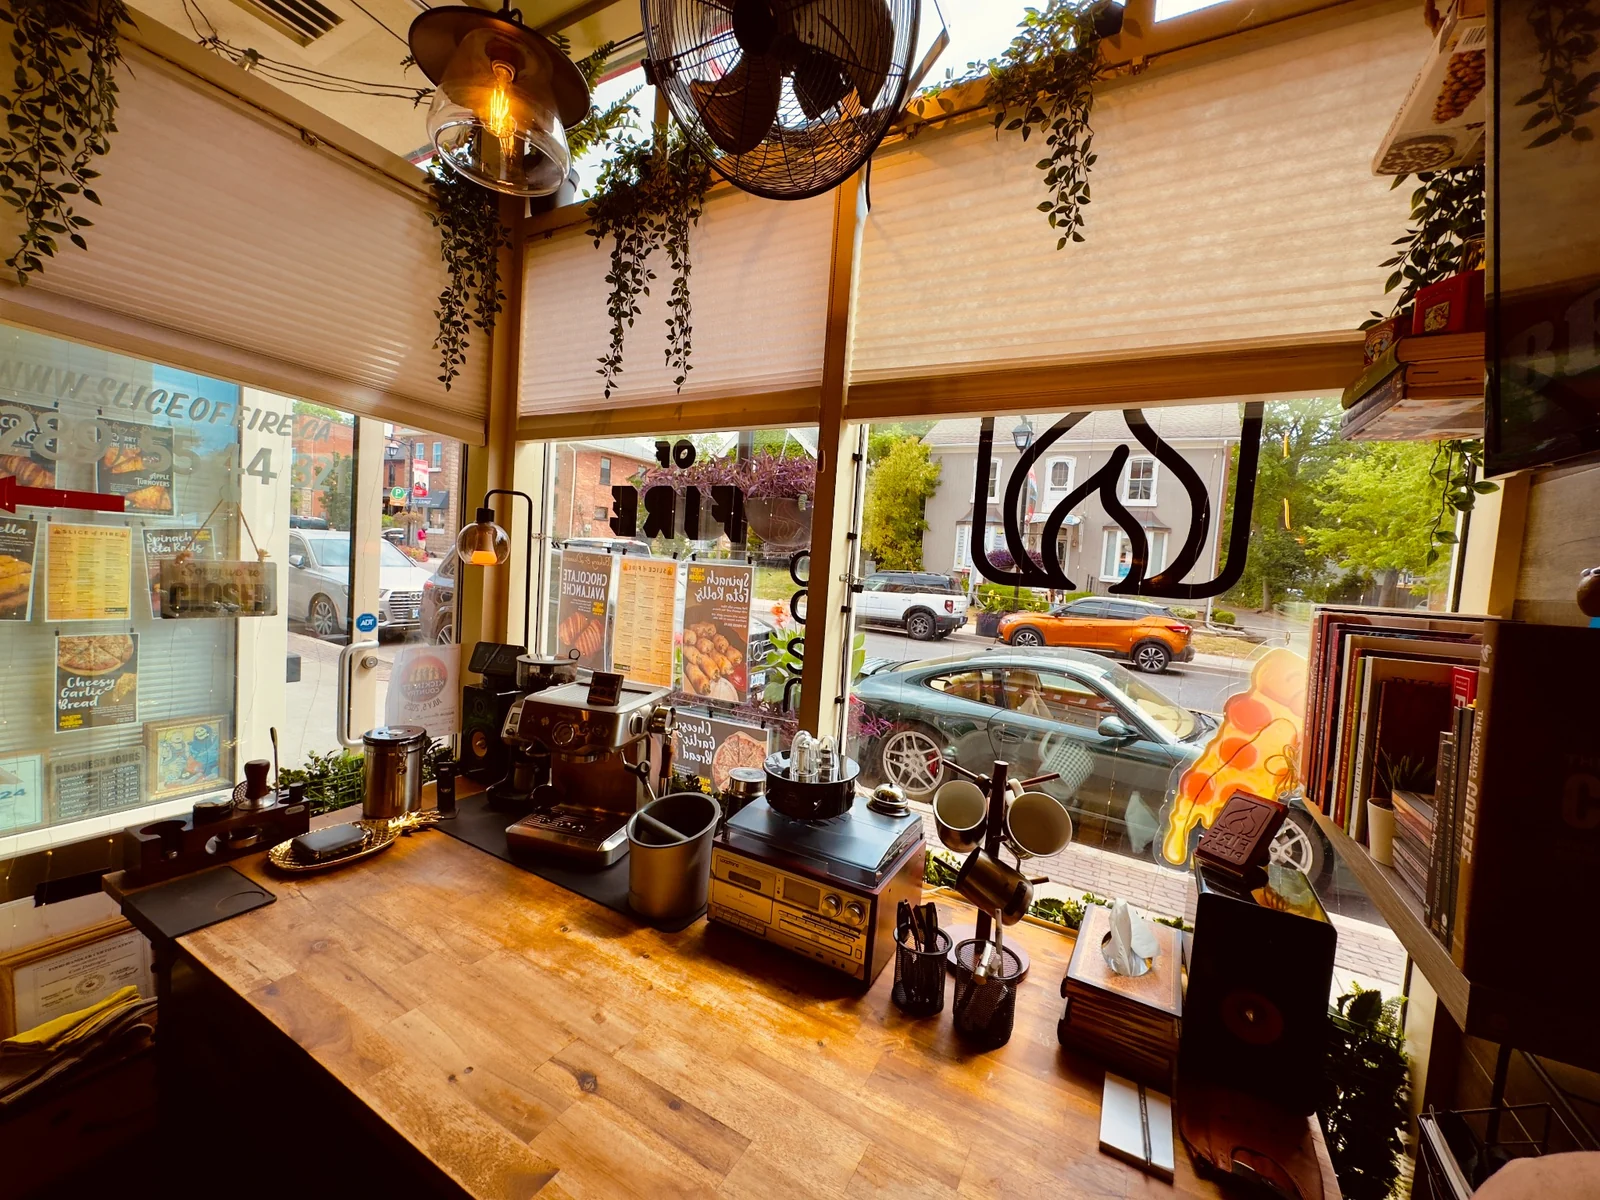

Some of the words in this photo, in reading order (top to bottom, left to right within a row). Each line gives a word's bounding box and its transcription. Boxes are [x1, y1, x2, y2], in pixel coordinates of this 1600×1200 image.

[146, 531, 192, 547] Spinach
[146, 541, 172, 555] Feta
[359, 617, 376, 628] ADT
[66, 676, 116, 691] Cheesy
[60, 686, 106, 699] Garlic
[58, 695, 100, 710] Bread
[1475, 710, 1484, 732] THE
[1471, 735, 1481, 778] WORLD
[55, 758, 107, 775] BUSINESS
[1461, 780, 1479, 864] COFFEE
